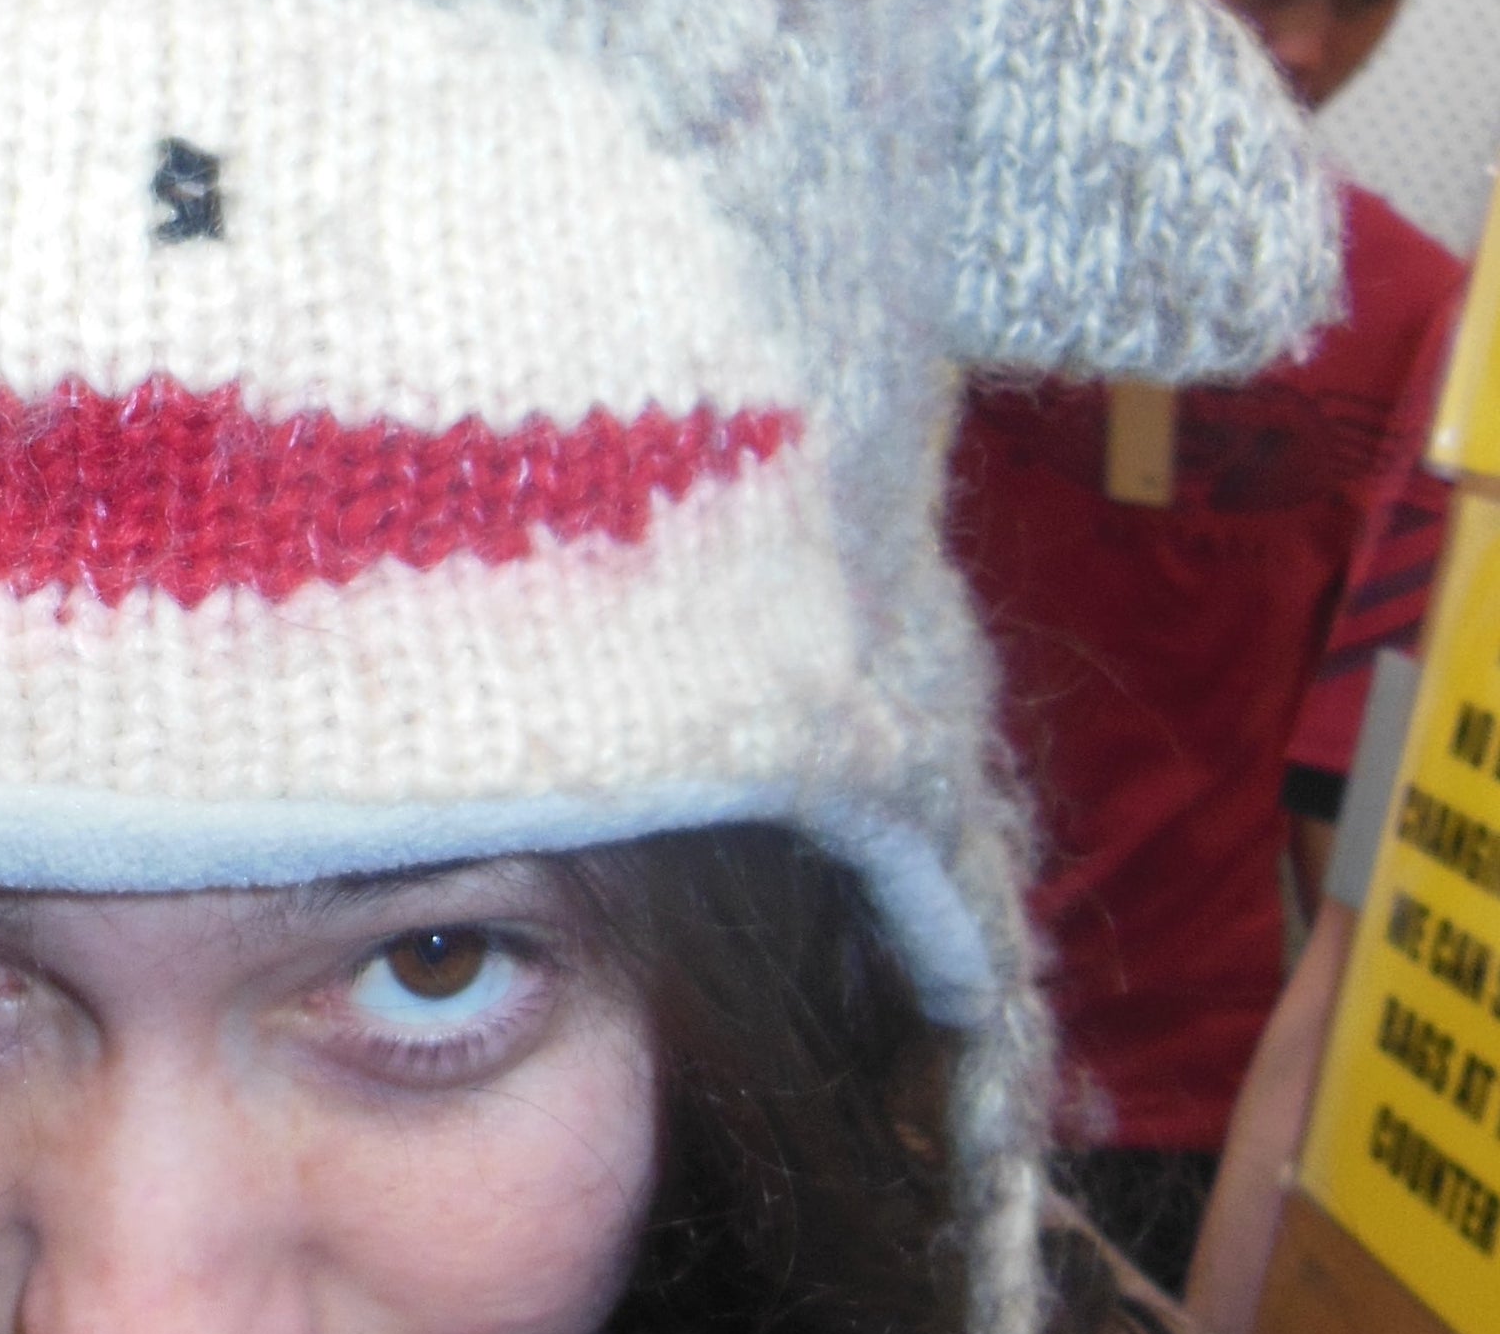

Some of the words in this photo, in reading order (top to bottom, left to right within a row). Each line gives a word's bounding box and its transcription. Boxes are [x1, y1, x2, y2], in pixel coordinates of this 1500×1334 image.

[1377, 993, 1456, 1096] BAGS
[1453, 1051, 1497, 1125] AT
[1370, 1101, 1500, 1257] COUNTER
